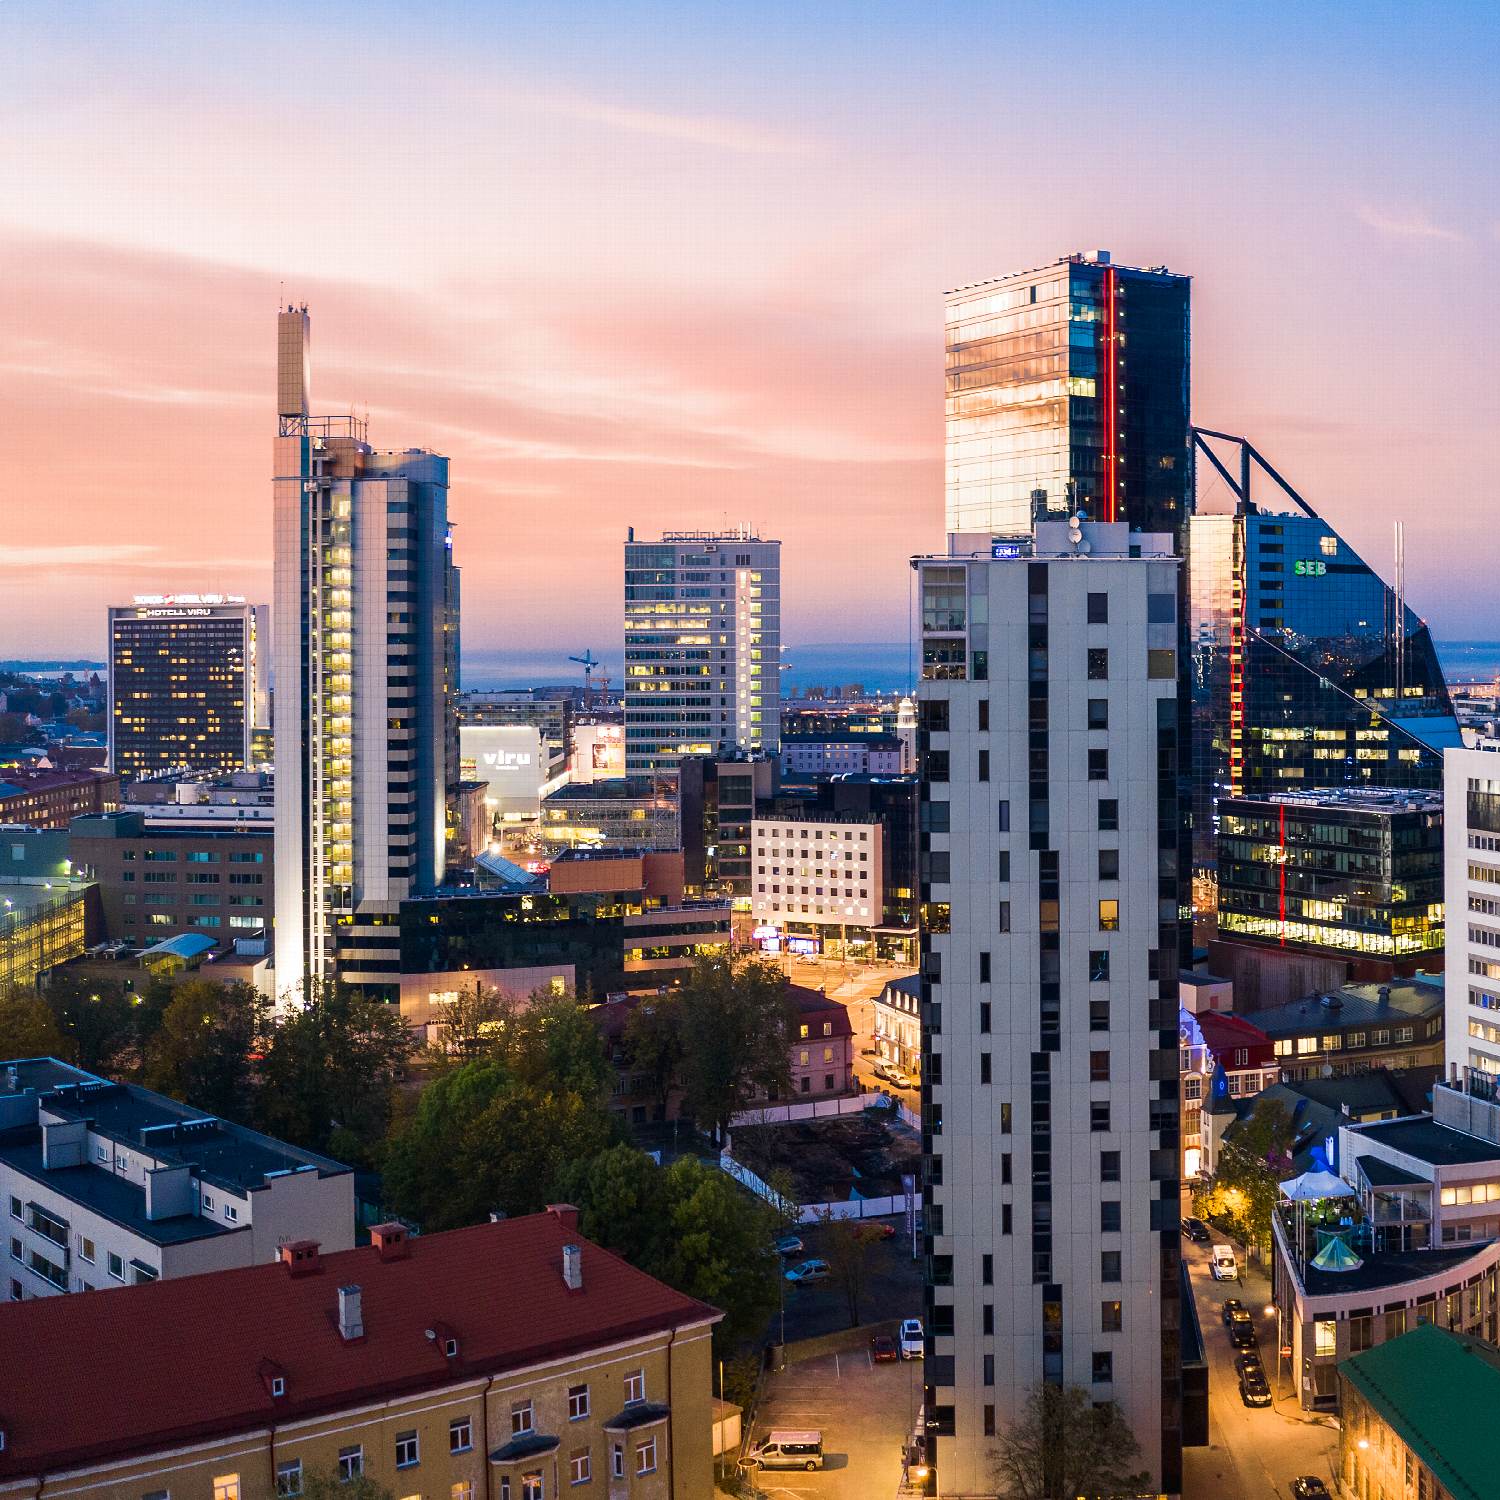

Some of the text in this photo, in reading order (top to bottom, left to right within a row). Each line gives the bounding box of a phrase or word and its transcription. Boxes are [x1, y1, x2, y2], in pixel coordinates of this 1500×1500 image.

[1295, 560, 1327, 576] SEB
[187, 608, 211, 616] VIRU
[483, 750, 531, 765] viru
